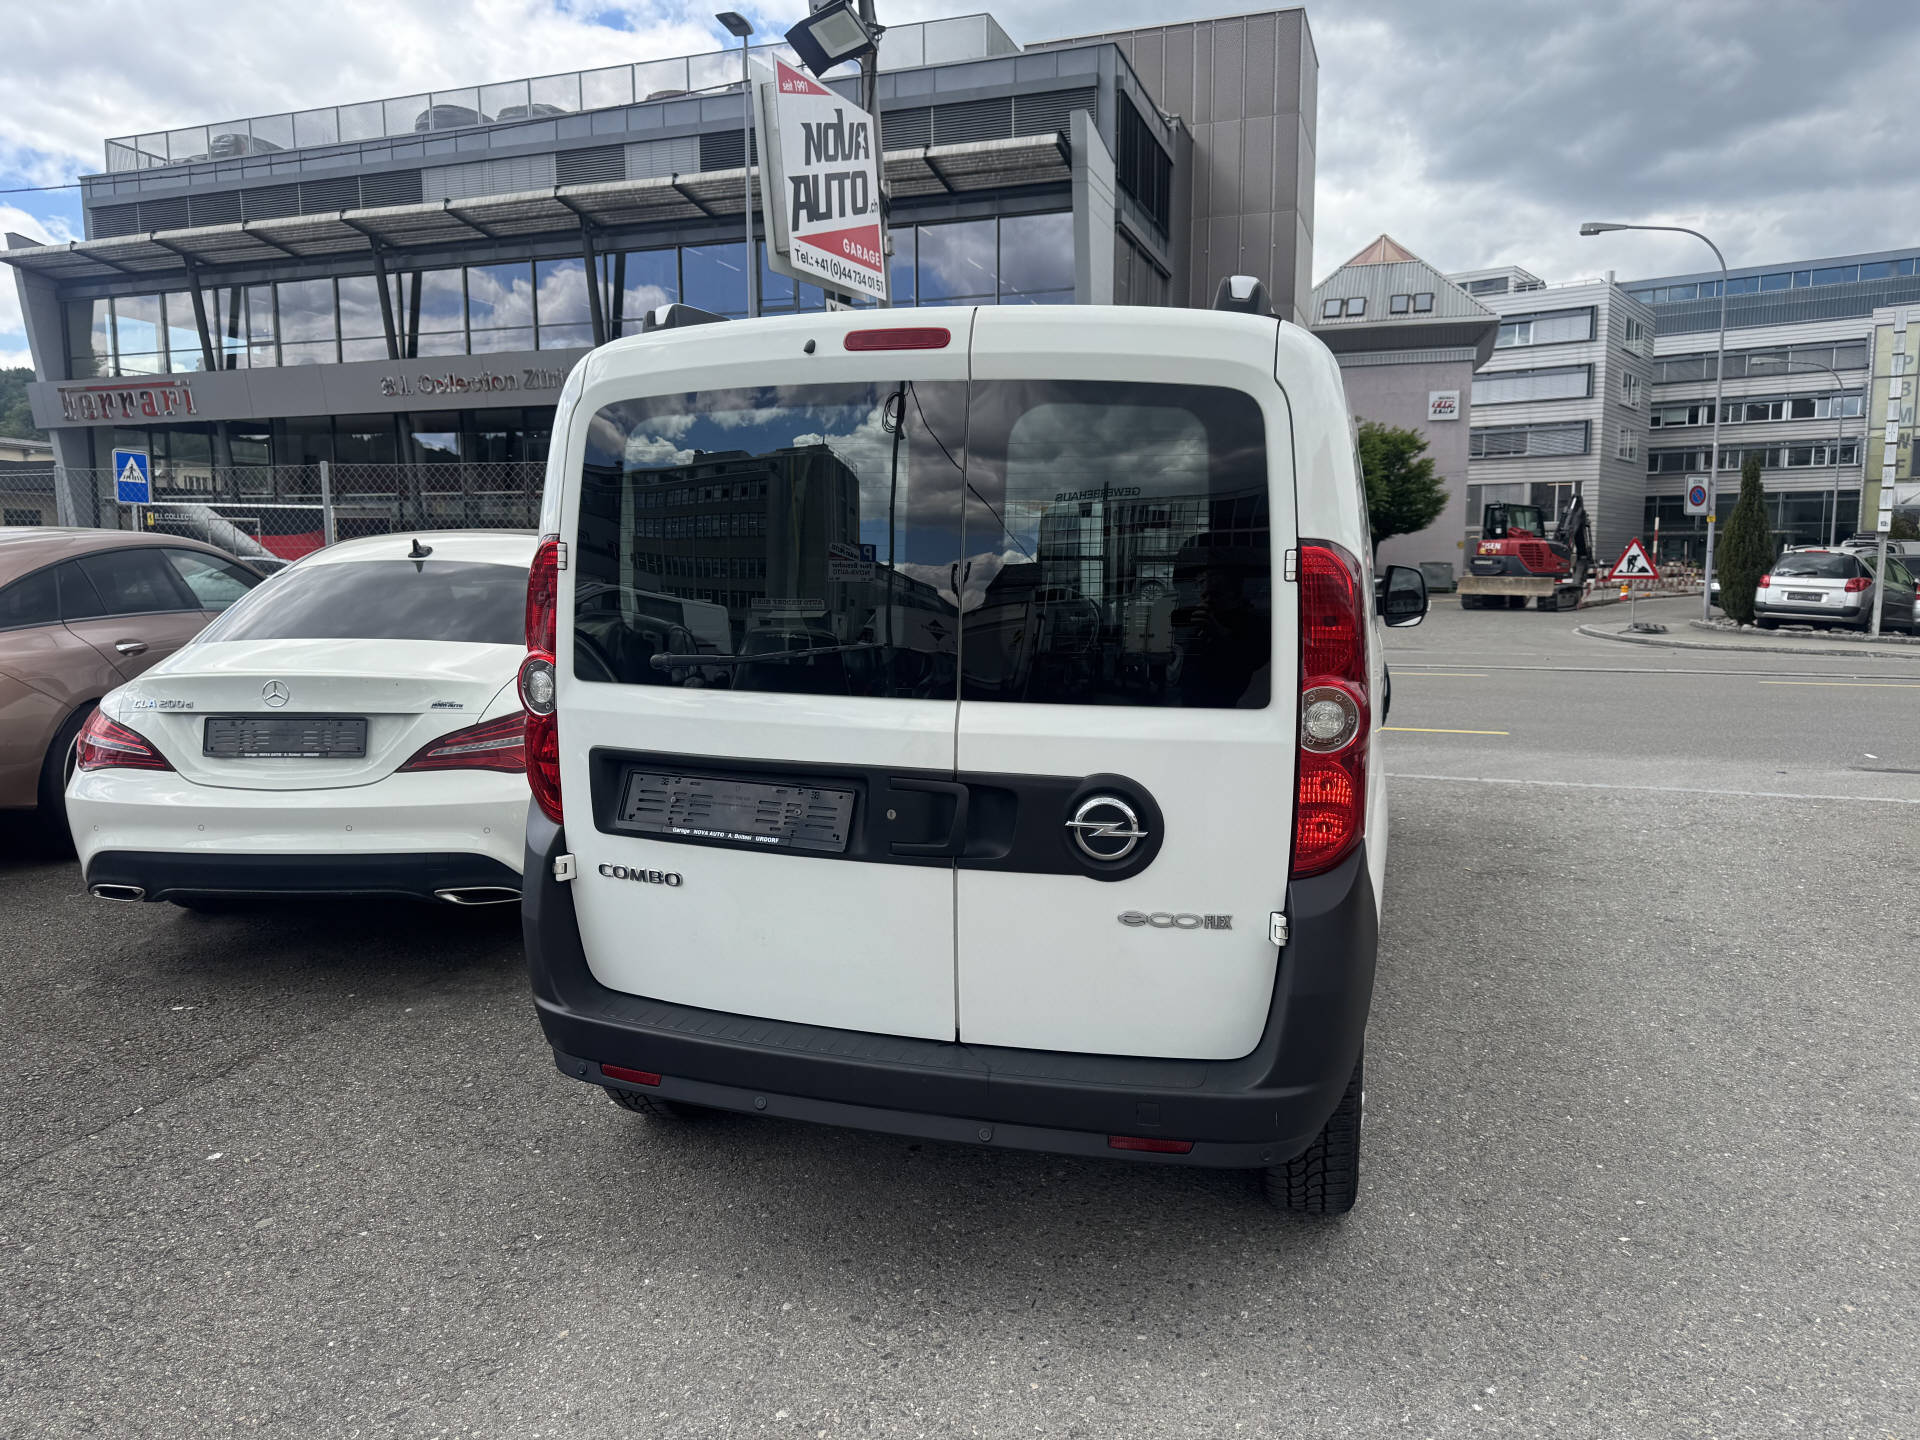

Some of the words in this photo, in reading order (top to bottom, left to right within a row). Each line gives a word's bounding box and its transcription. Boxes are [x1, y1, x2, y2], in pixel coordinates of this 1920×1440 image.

[782, 80, 793, 91] seit
[794, 80, 809, 92] 1991
[800, 108, 870, 167] NOVA
[842, 238, 881, 266] GARAGE
[795, 248, 814, 267] Tel.:
[815, 257, 829, 272] +41
[853, 270, 866, 287] 734
[868, 276, 875, 289] 01
[876, 279, 884, 293] 51
[418, 371, 519, 394] Collection
[57, 379, 197, 421] Ferrari
[132, 699, 158, 709] CLA
[672, 826, 690, 834] Garage
[598, 862, 684, 887] COMBO
